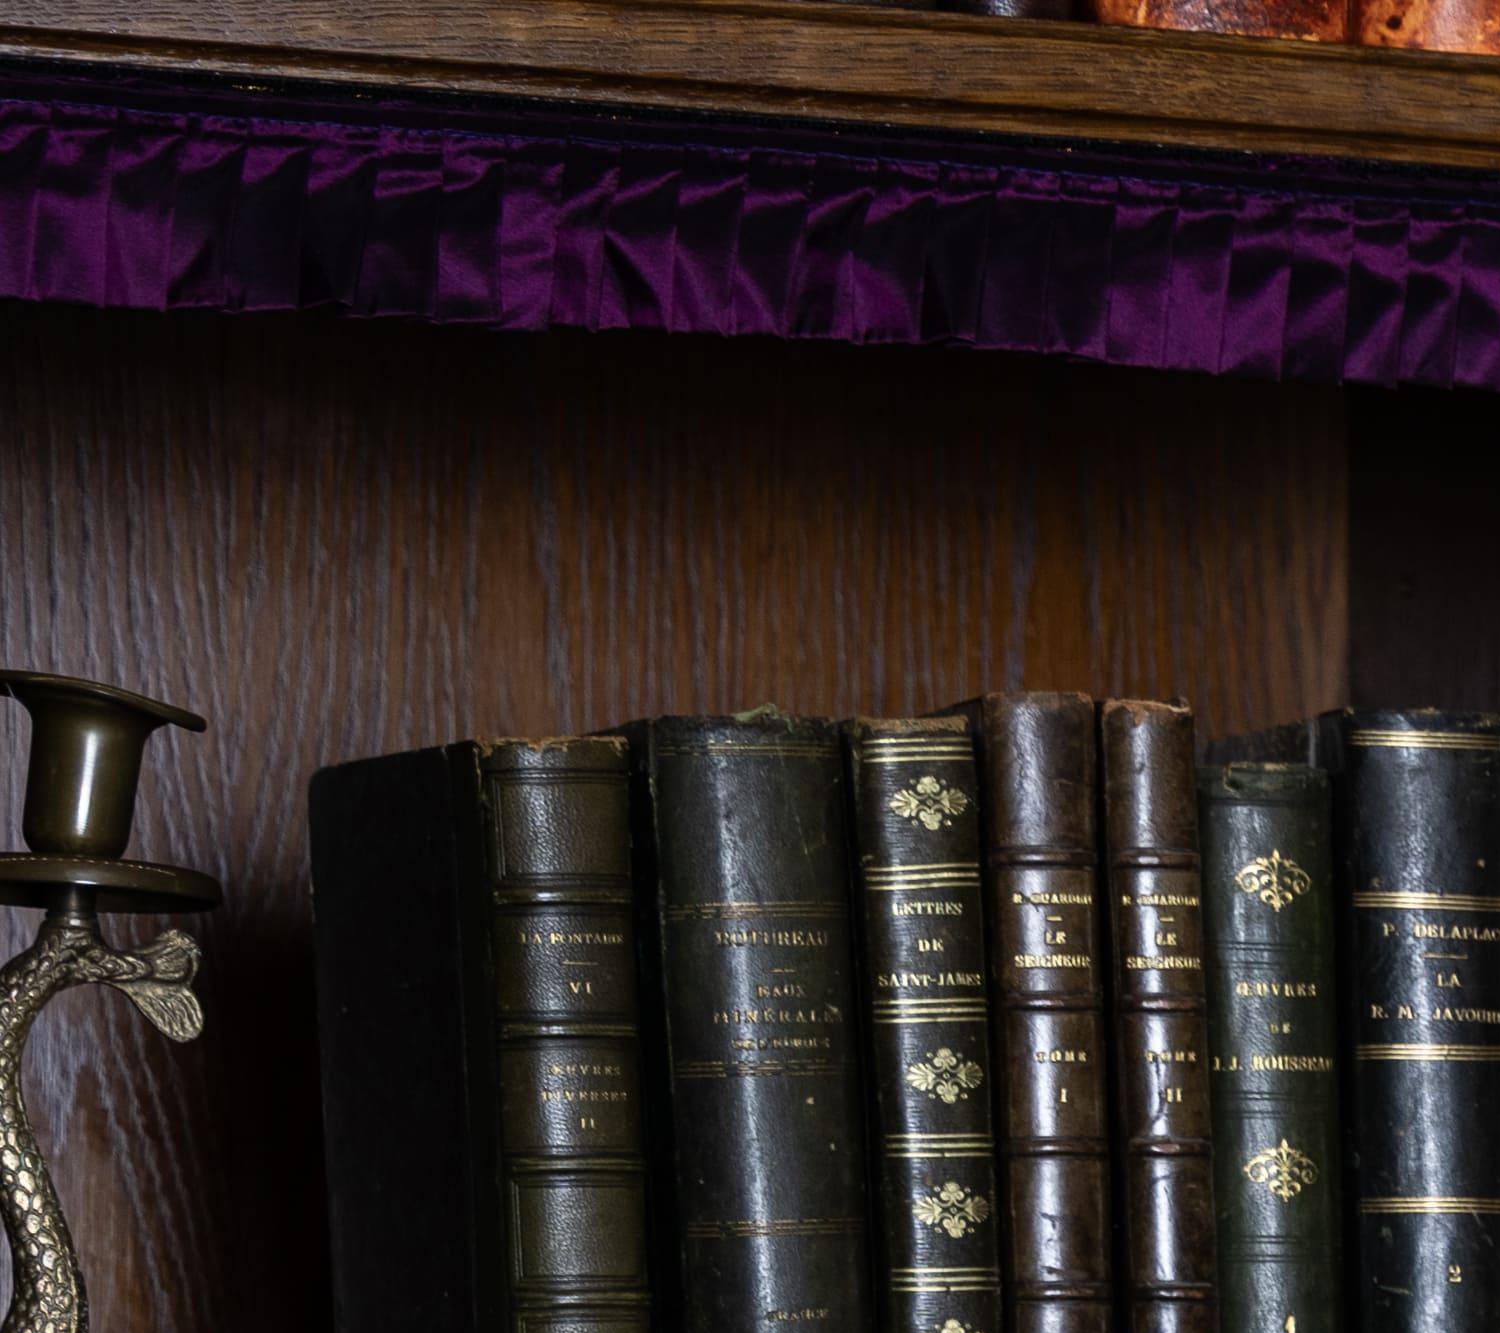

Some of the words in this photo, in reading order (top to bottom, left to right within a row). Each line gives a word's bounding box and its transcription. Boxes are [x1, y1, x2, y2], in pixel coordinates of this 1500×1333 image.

[892, 901, 964, 917] LETTRES
[1383, 921, 1399, 937] P.
[1044, 929, 1067, 945] LE
[1154, 930, 1177, 947] LE
[918, 939, 944, 953] DE
[1014, 954, 1091, 969] SEIGNEUR
[1126, 955, 1201, 970] SEIGNEUR
[1435, 972, 1461, 988] LA
[569, 982, 594, 996] VI
[757, 985, 805, 999] EAUX
[1370, 1003, 1389, 1021] R.
[1035, 1049, 1087, 1064] TOME
[1165, 1088, 1183, 1104] II
[580, 1117, 596, 1130] II
